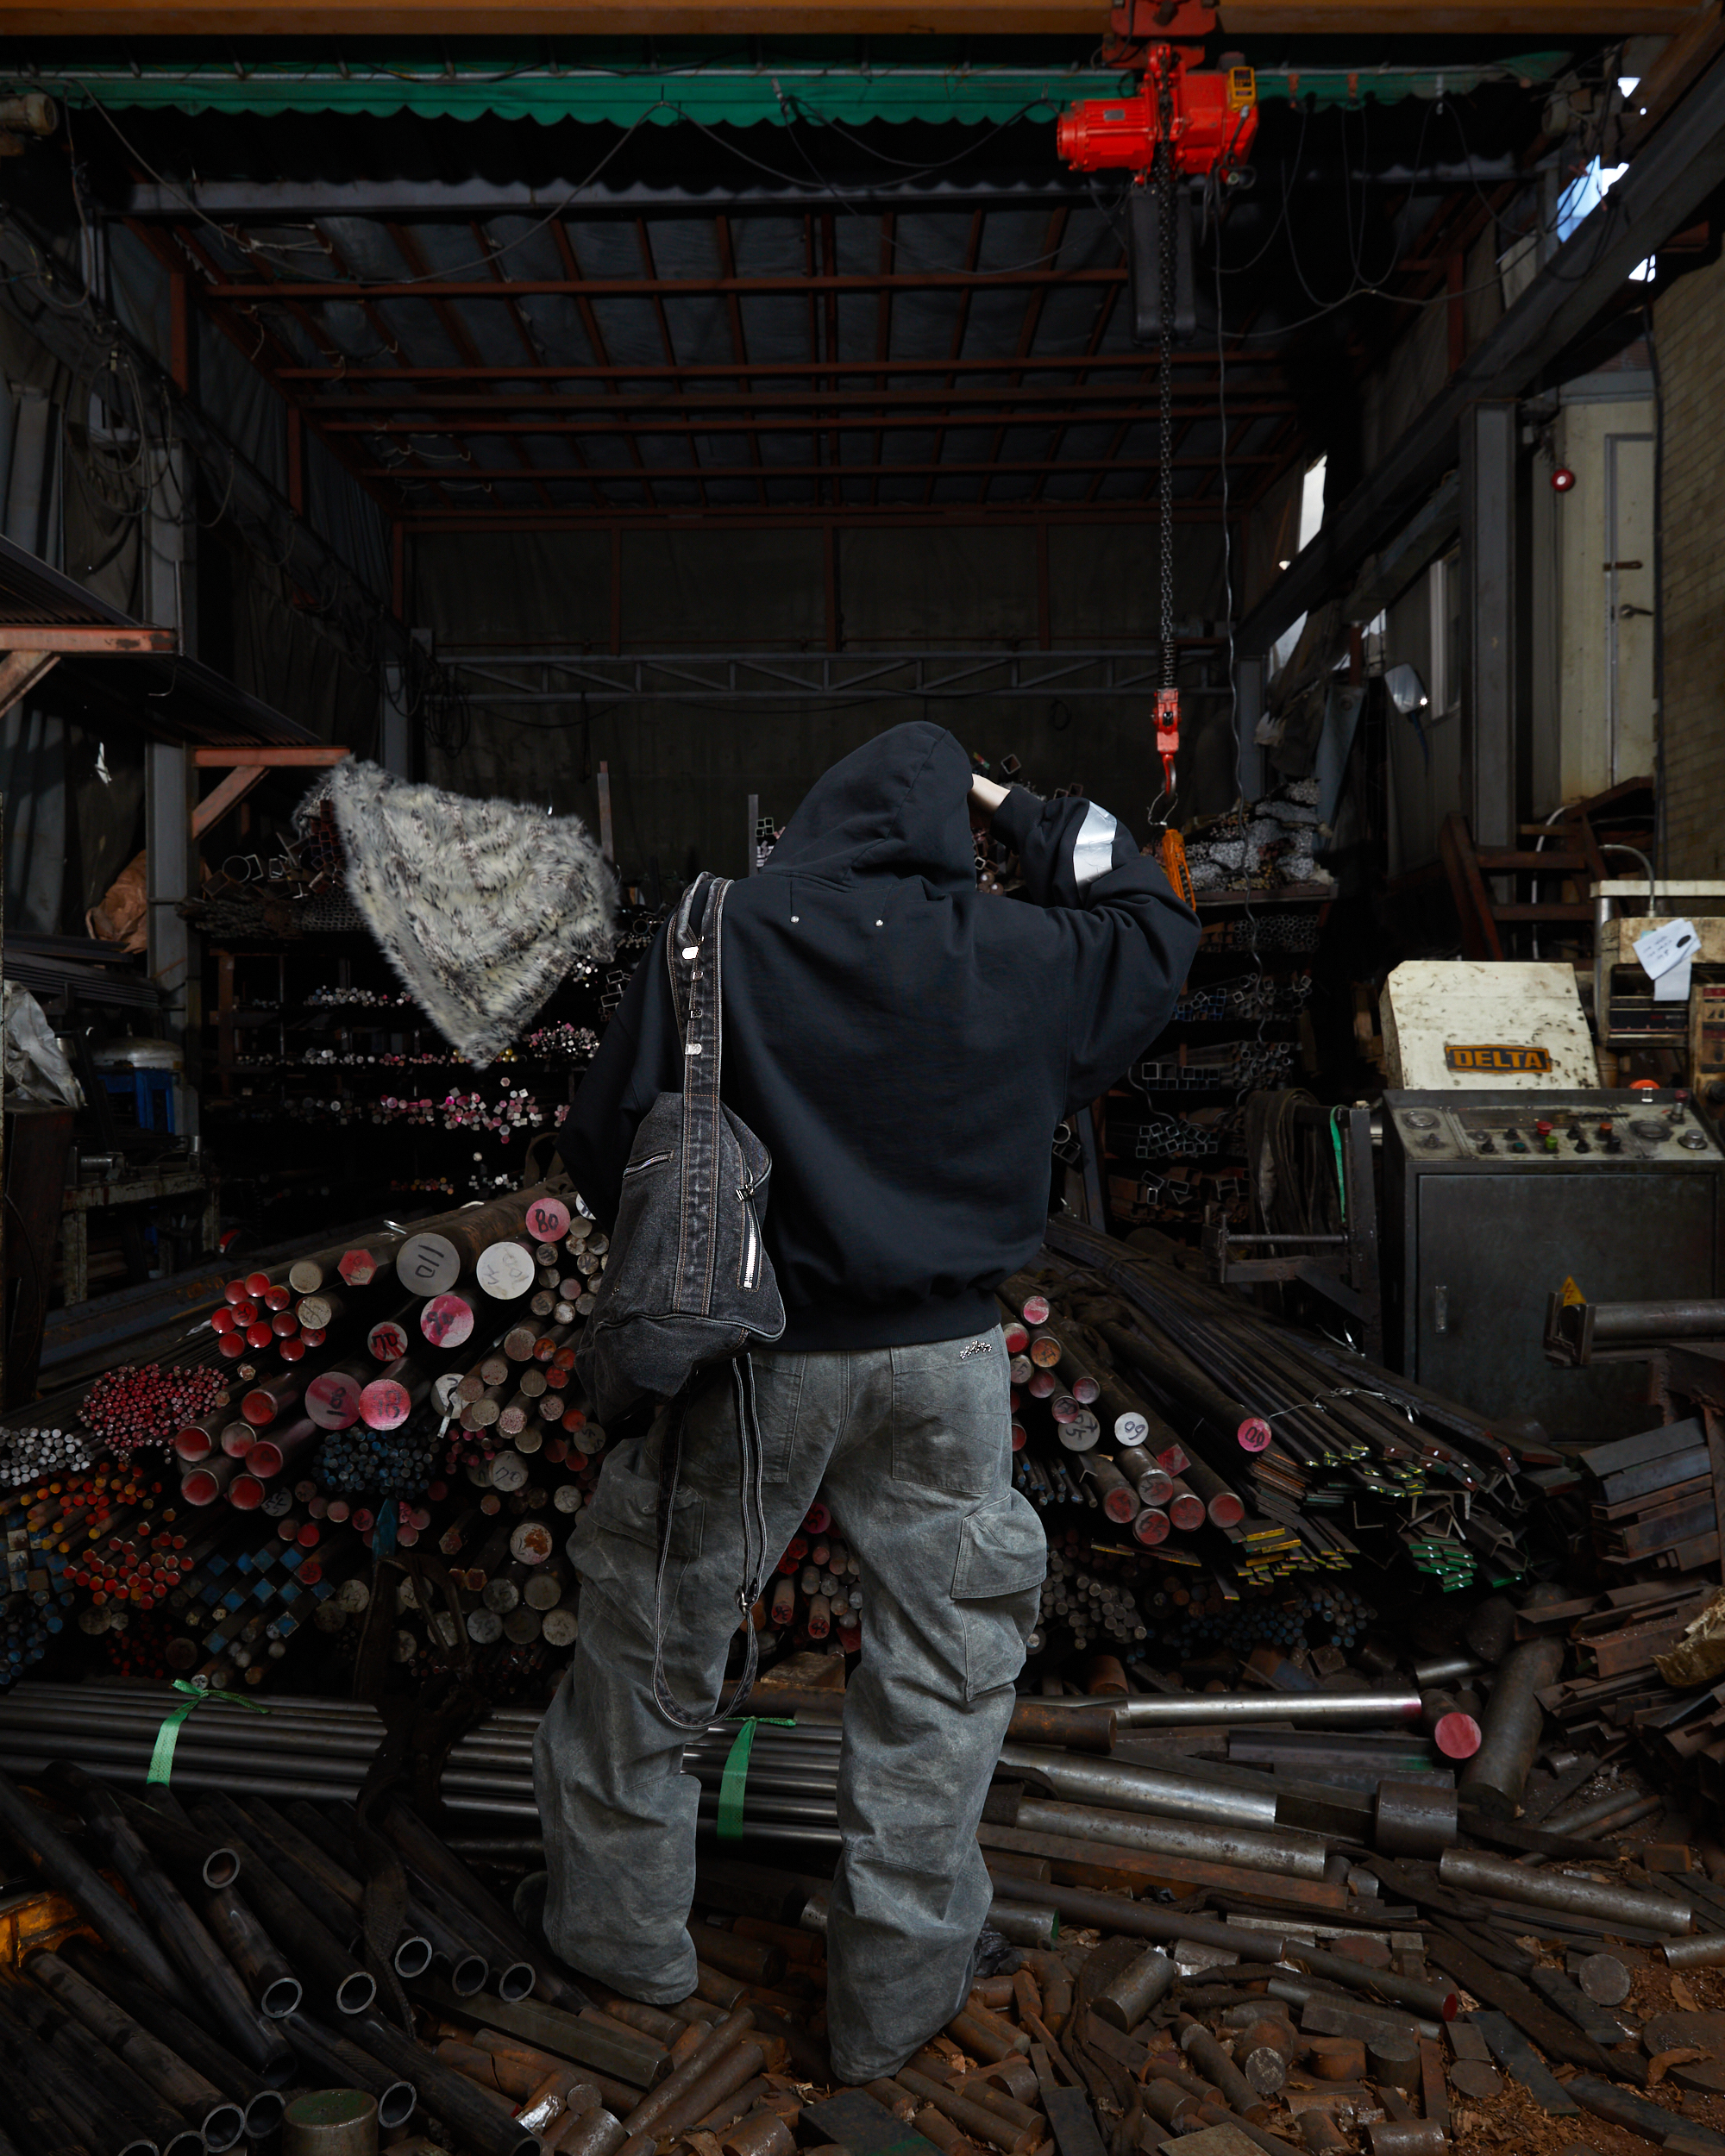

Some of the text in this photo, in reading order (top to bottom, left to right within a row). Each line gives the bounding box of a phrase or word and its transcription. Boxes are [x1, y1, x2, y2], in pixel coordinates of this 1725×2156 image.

[1453, 1050, 1543, 1068] DELTA
[535, 1208, 559, 1233] 80
[426, 1311, 455, 1336] 90
[372, 1332, 398, 1359] 70
